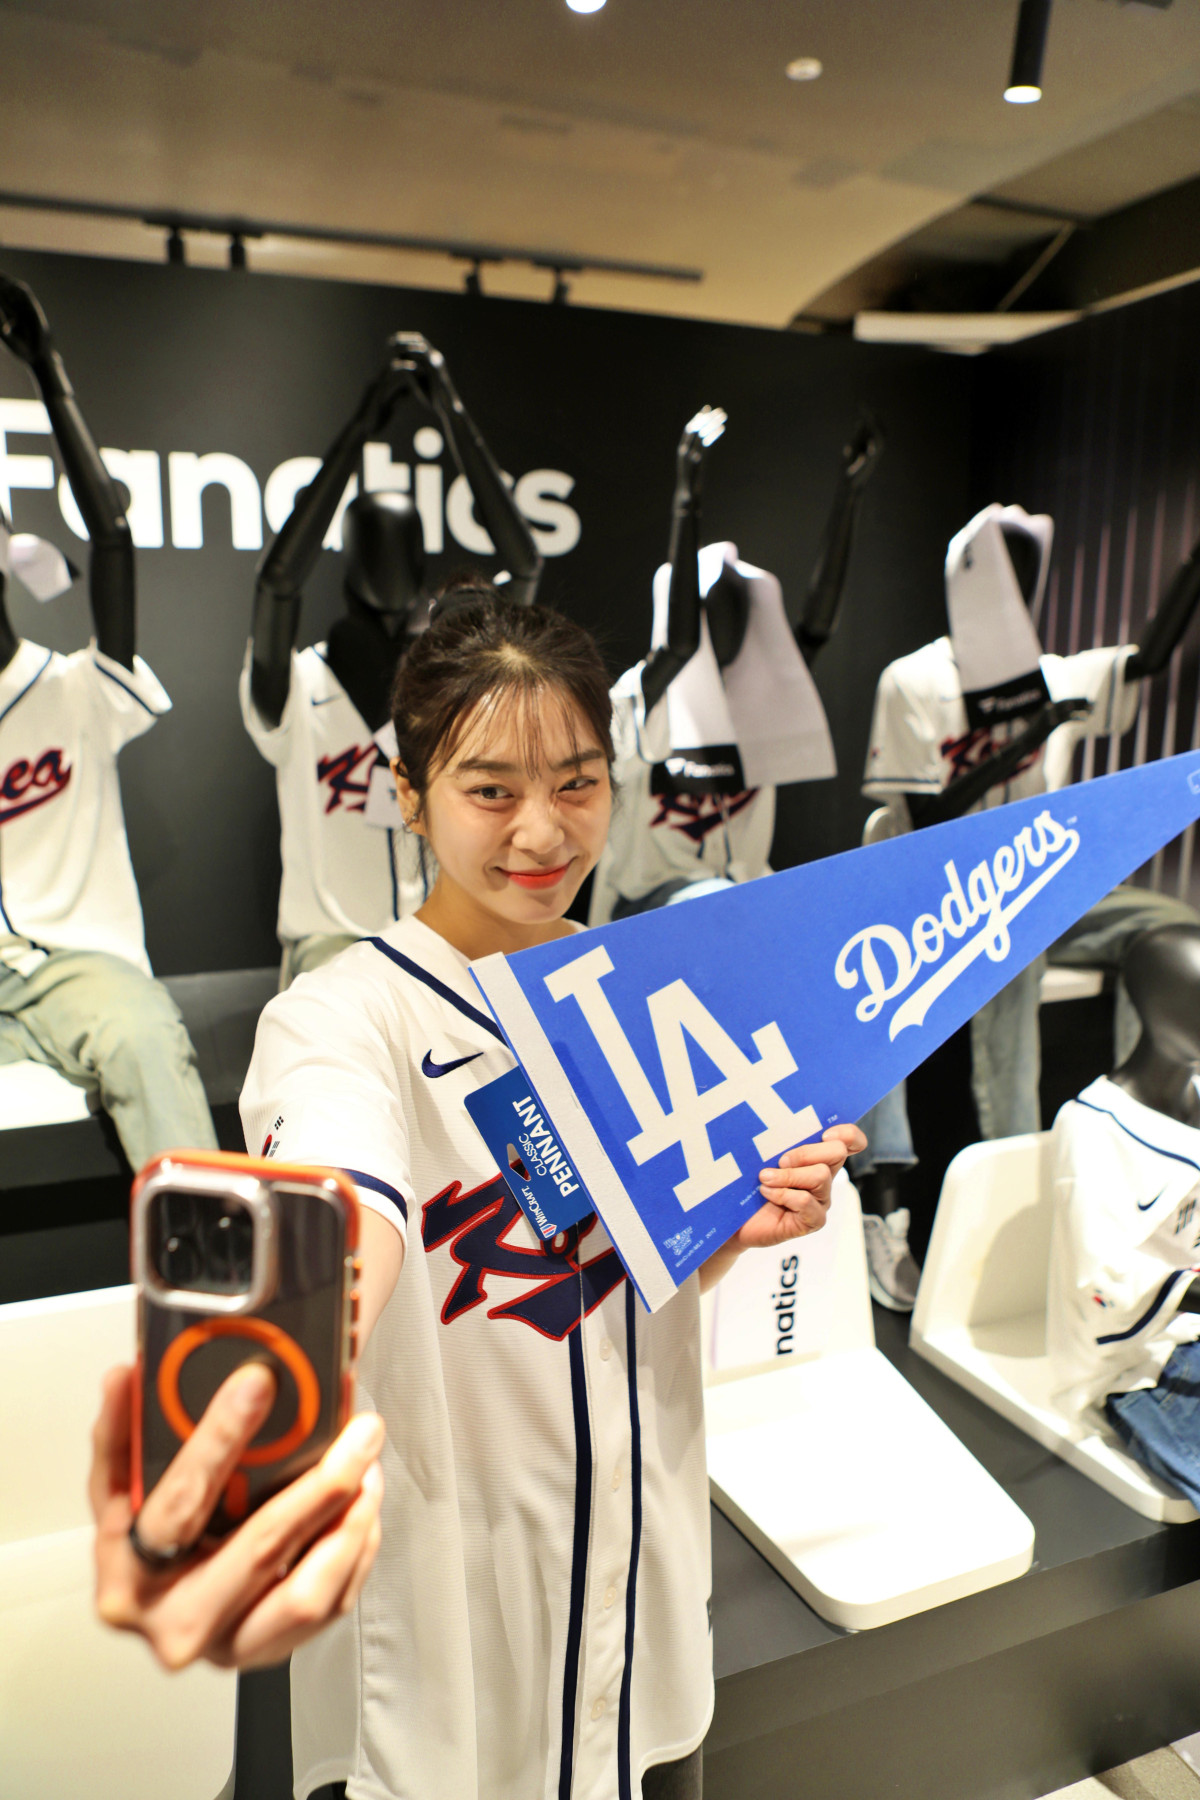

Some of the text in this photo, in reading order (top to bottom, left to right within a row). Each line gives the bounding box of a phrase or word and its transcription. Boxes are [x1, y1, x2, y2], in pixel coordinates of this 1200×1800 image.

[834, 810, 1080, 1042] Dodgers
[512, 1096, 580, 1198] PENNANT
[518, 1132, 548, 1177] CLASSIC
[543, 944, 824, 1212] LA
